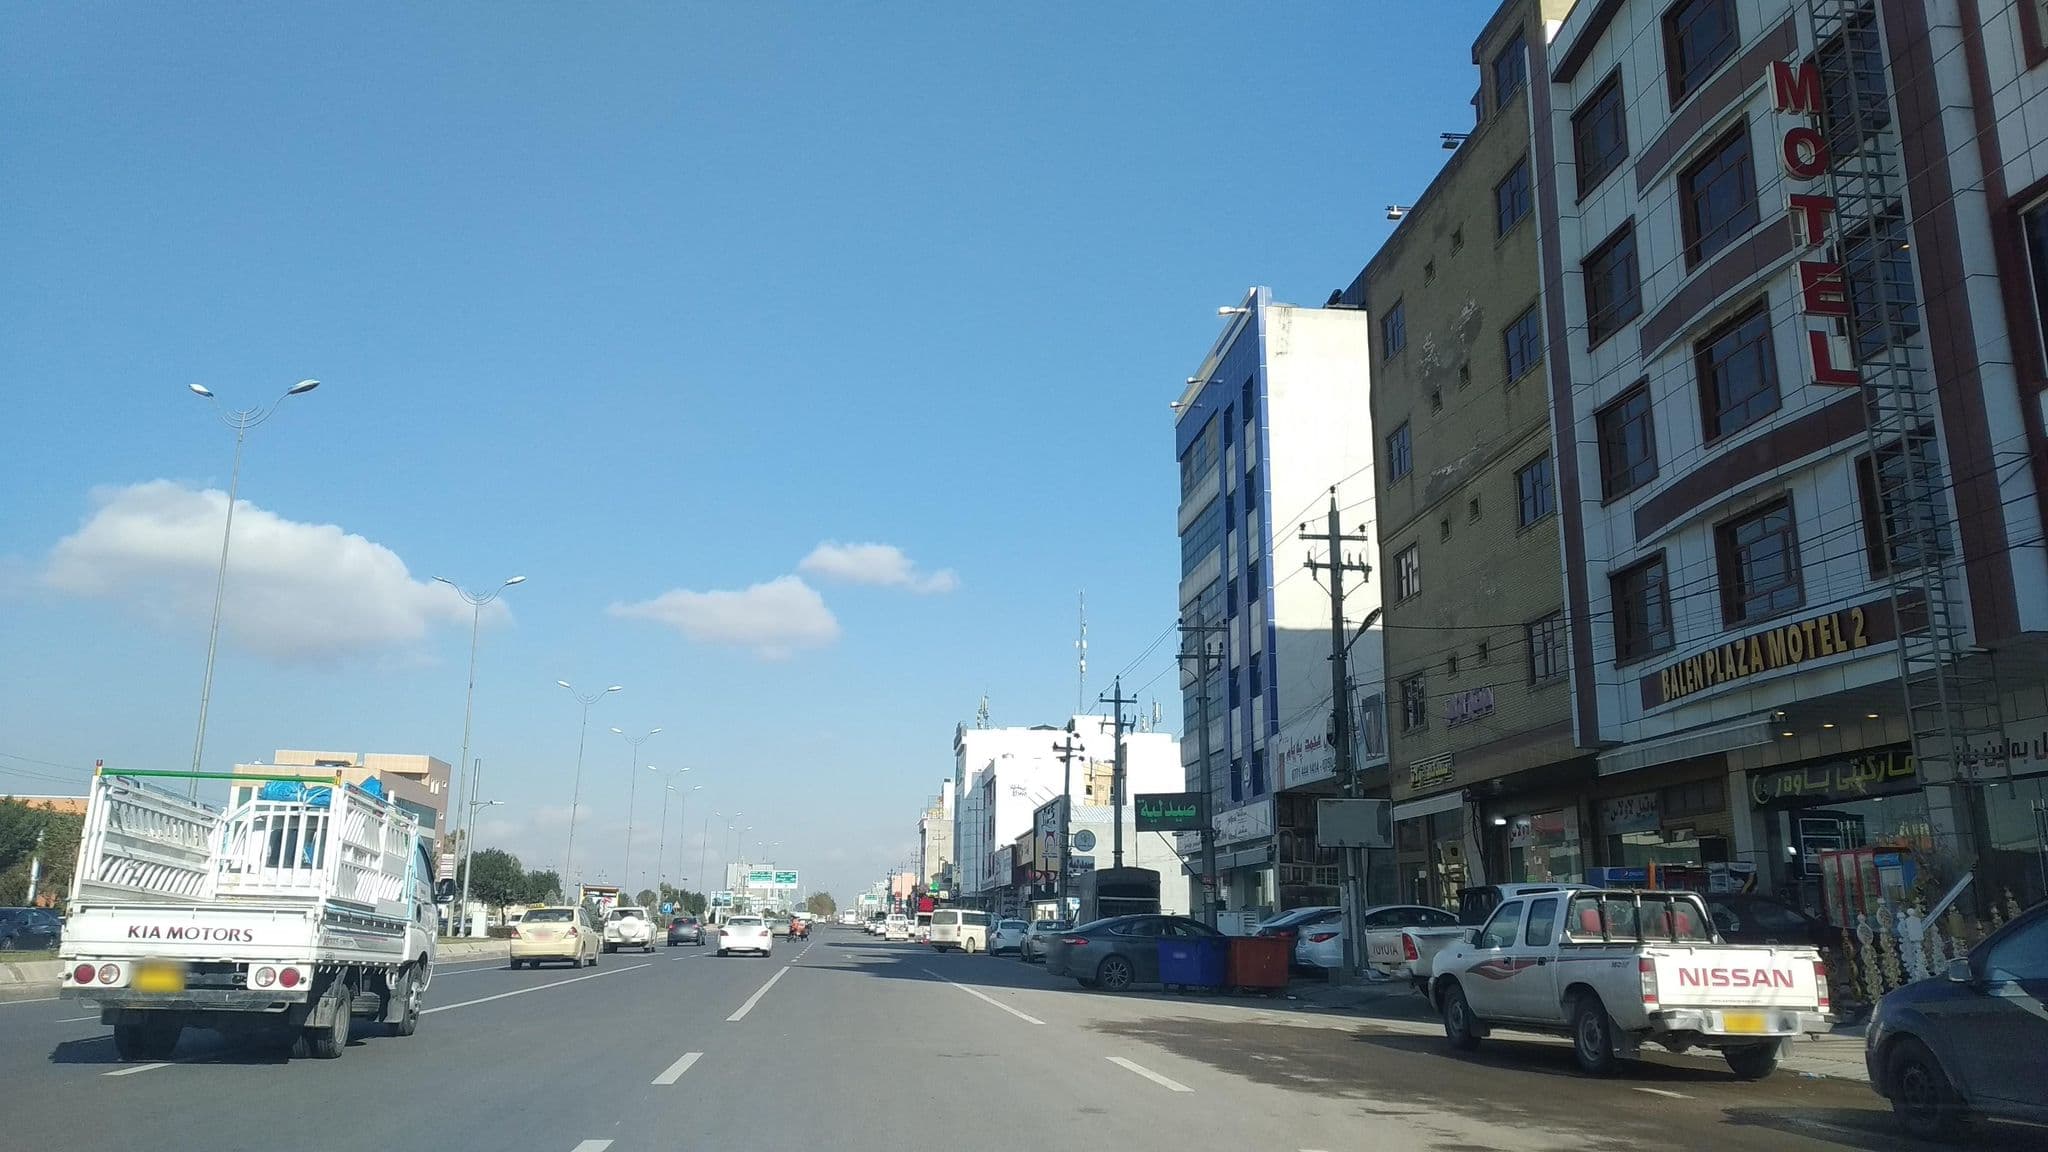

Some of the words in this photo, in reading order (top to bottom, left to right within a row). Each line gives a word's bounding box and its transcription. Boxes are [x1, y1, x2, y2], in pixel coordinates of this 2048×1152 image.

[1766, 61, 1861, 386] MOTEL
[1661, 654, 1704, 702] BALEN
[1706, 635, 1764, 686] PLAZA
[1766, 612, 1848, 669] MOTEL
[1851, 607, 1868, 649] 2
[128, 925, 161, 939] KIA
[166, 926, 253, 942] MOTORS
[1679, 967, 1795, 988] NISSAN
